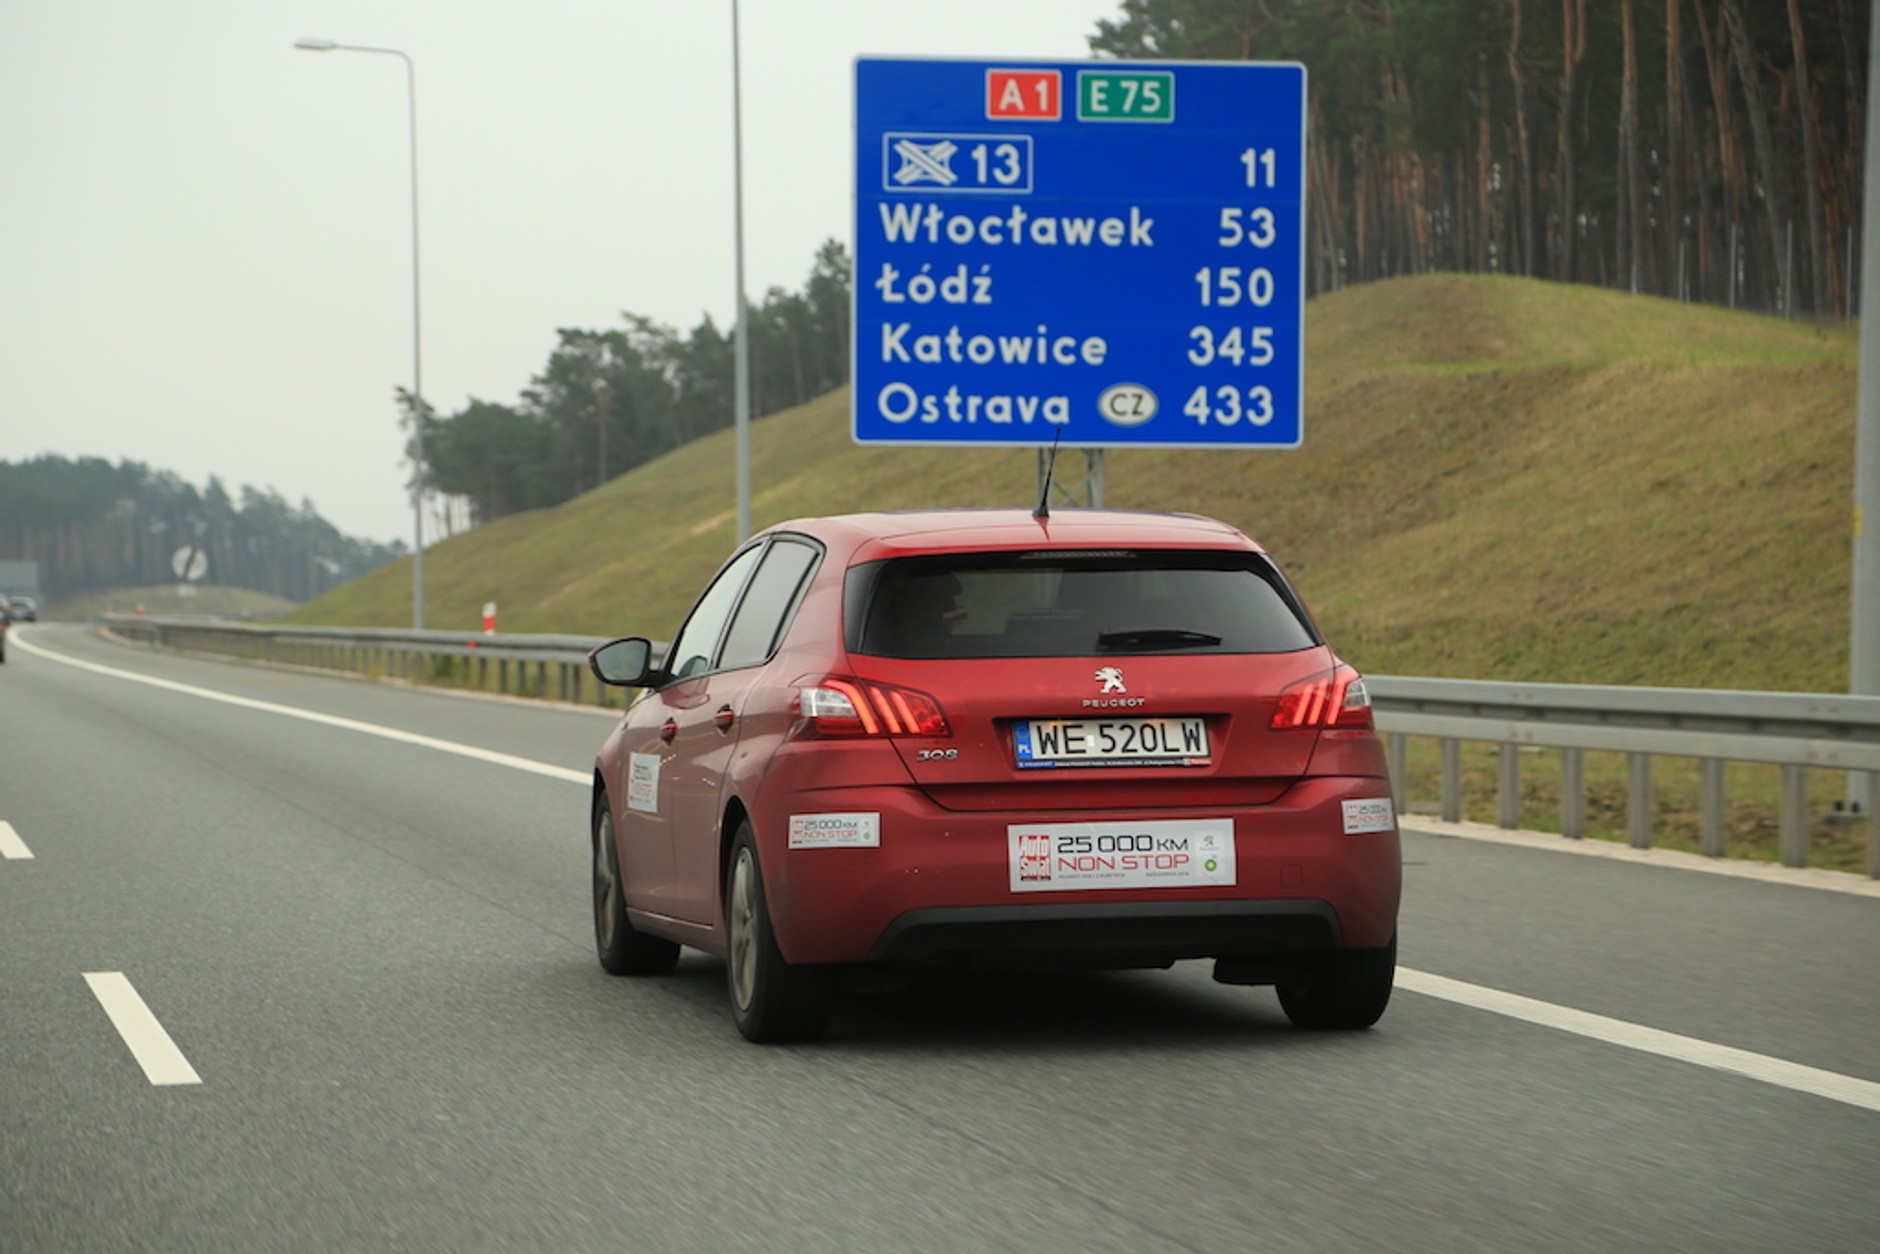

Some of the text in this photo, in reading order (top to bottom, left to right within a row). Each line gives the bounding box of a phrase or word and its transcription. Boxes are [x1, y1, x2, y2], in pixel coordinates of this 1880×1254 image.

[999, 79, 1049, 111] A 1
[1090, 81, 1161, 113] E 75
[971, 143, 1275, 188] 13 11
[879, 203, 1276, 248] Włocławek 53
[875, 263, 1274, 307] Łódź 150
[882, 323, 1274, 366] Katowice 345
[878, 382, 1274, 426] Ostrava CZ 433
[1082, 698, 1146, 708] PEUGEOT
[1036, 721, 1202, 755] WE 520LW
[916, 749, 959, 761] 308
[804, 828, 857, 838] NON STOP
[819, 819, 842, 829] 000
[1057, 834, 1190, 854] 25 000 KM
[1057, 856, 1116, 872] NON
[1121, 853, 1190, 870] STOP
